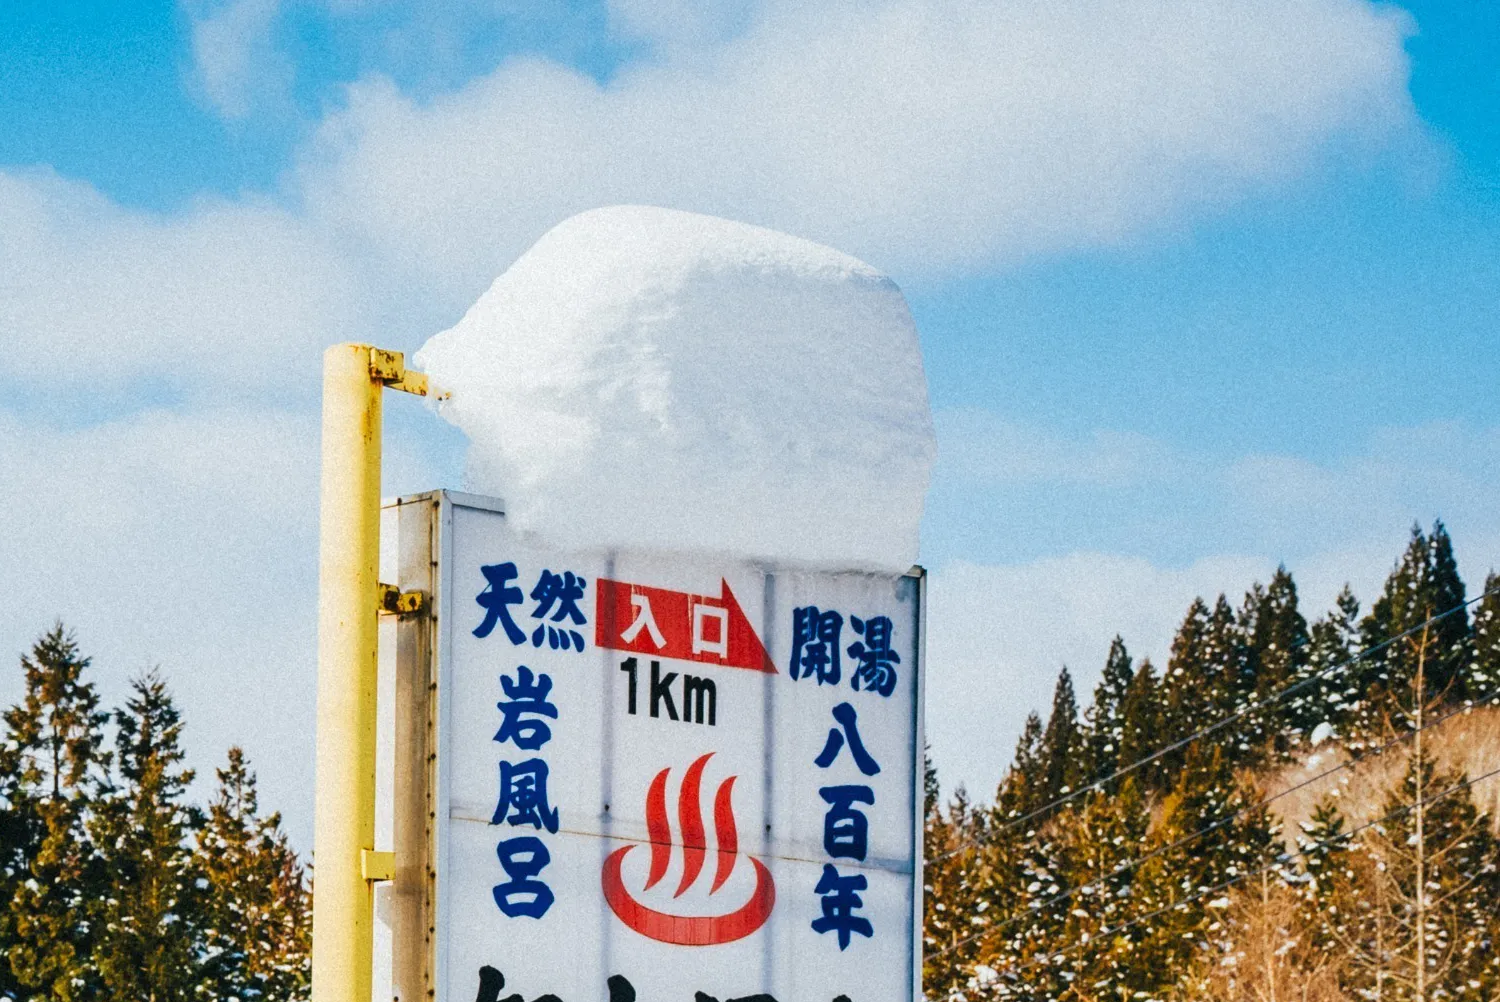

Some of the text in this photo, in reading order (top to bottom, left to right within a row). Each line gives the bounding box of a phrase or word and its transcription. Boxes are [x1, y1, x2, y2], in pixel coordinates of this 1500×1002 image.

[472, 562, 587, 653] 天然
[620, 594, 730, 660] 入口
[789, 606, 901, 698] 開湯
[619, 656, 717, 726] 1km
[489, 665, 560, 920] 岩風呂
[811, 702, 881, 951] 八百年
